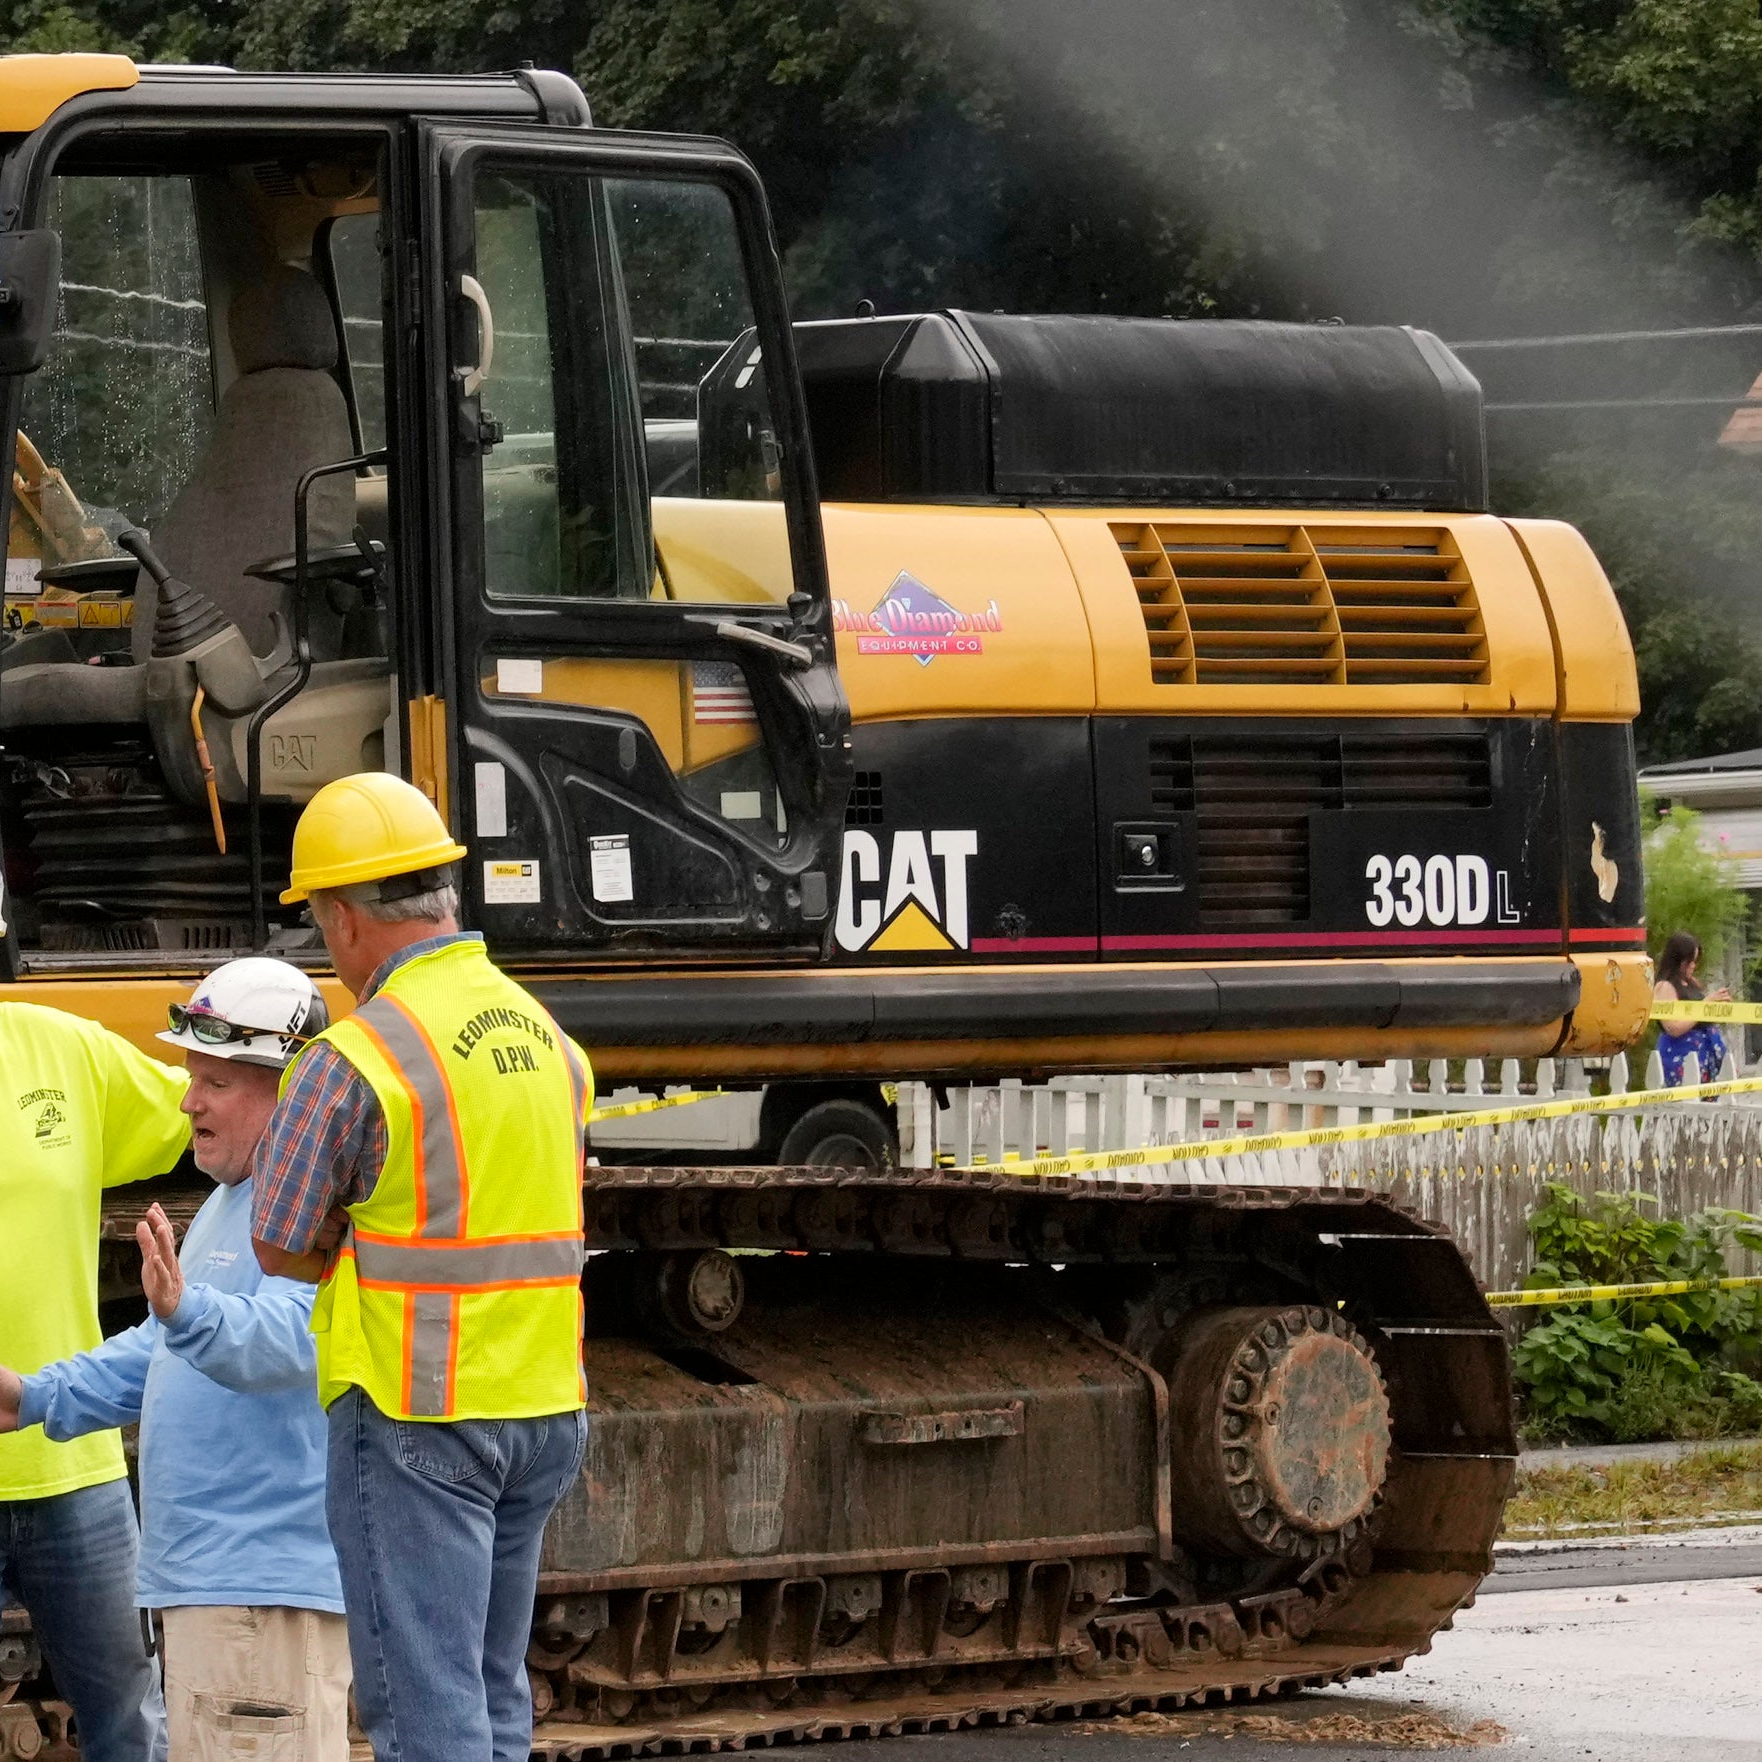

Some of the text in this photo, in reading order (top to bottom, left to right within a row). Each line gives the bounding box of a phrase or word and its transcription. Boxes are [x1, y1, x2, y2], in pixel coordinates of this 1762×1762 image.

[831, 598, 1004, 633] Blue Diamond
[834, 830, 977, 952] CAT
[1365, 854, 1520, 927] 330D L
[451, 1007, 554, 1061] LEOMINSTER
[491, 1045, 540, 1075] D.P.W.
